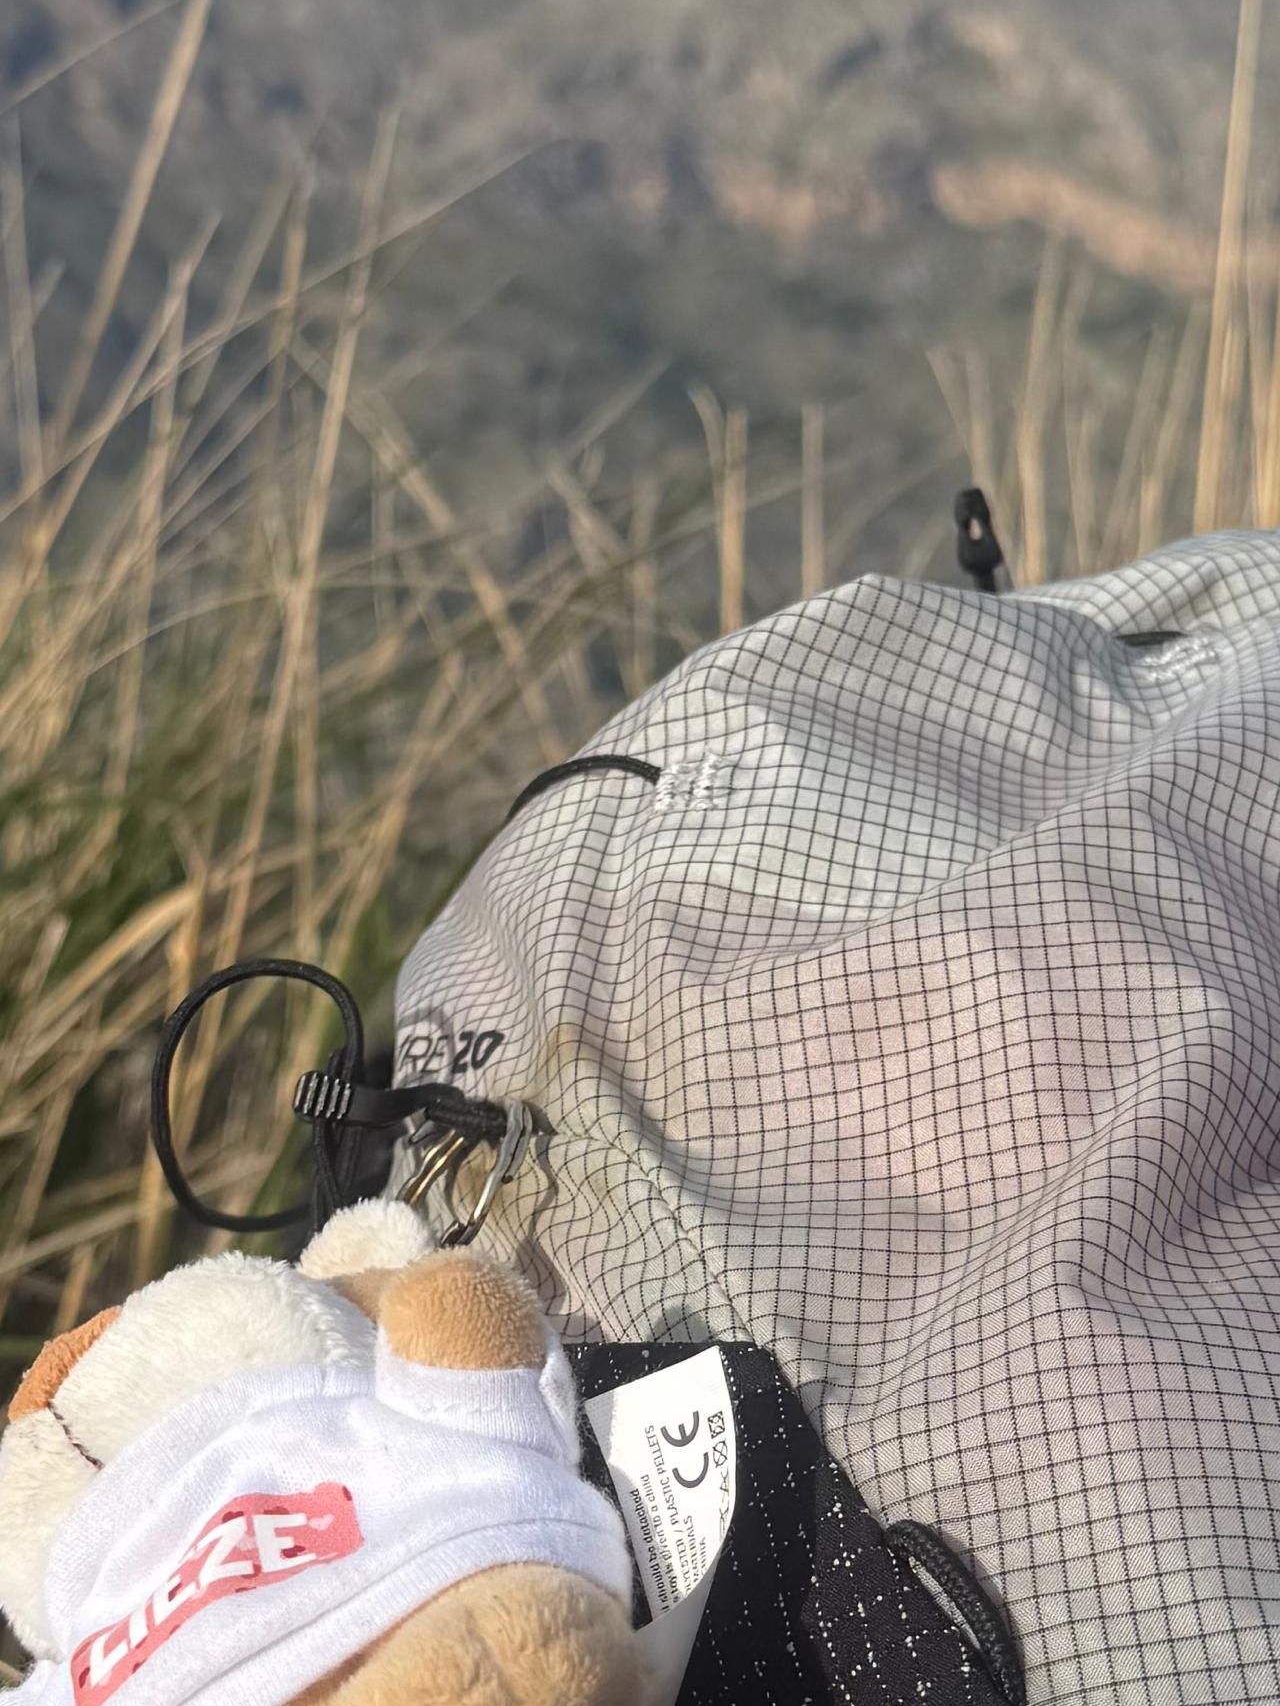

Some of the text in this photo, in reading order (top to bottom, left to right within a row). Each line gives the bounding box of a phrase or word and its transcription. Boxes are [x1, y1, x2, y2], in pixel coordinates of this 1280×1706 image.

[451, 1030, 505, 1073] 20
[644, 1425, 667, 1475] PELLETS
[661, 1411, 709, 1488] CE
[640, 1474, 656, 1502] child
[659, 1476, 679, 1526] PLASTIC
[630, 1488, 653, 1544] detached
[649, 1563, 670, 1604] should
